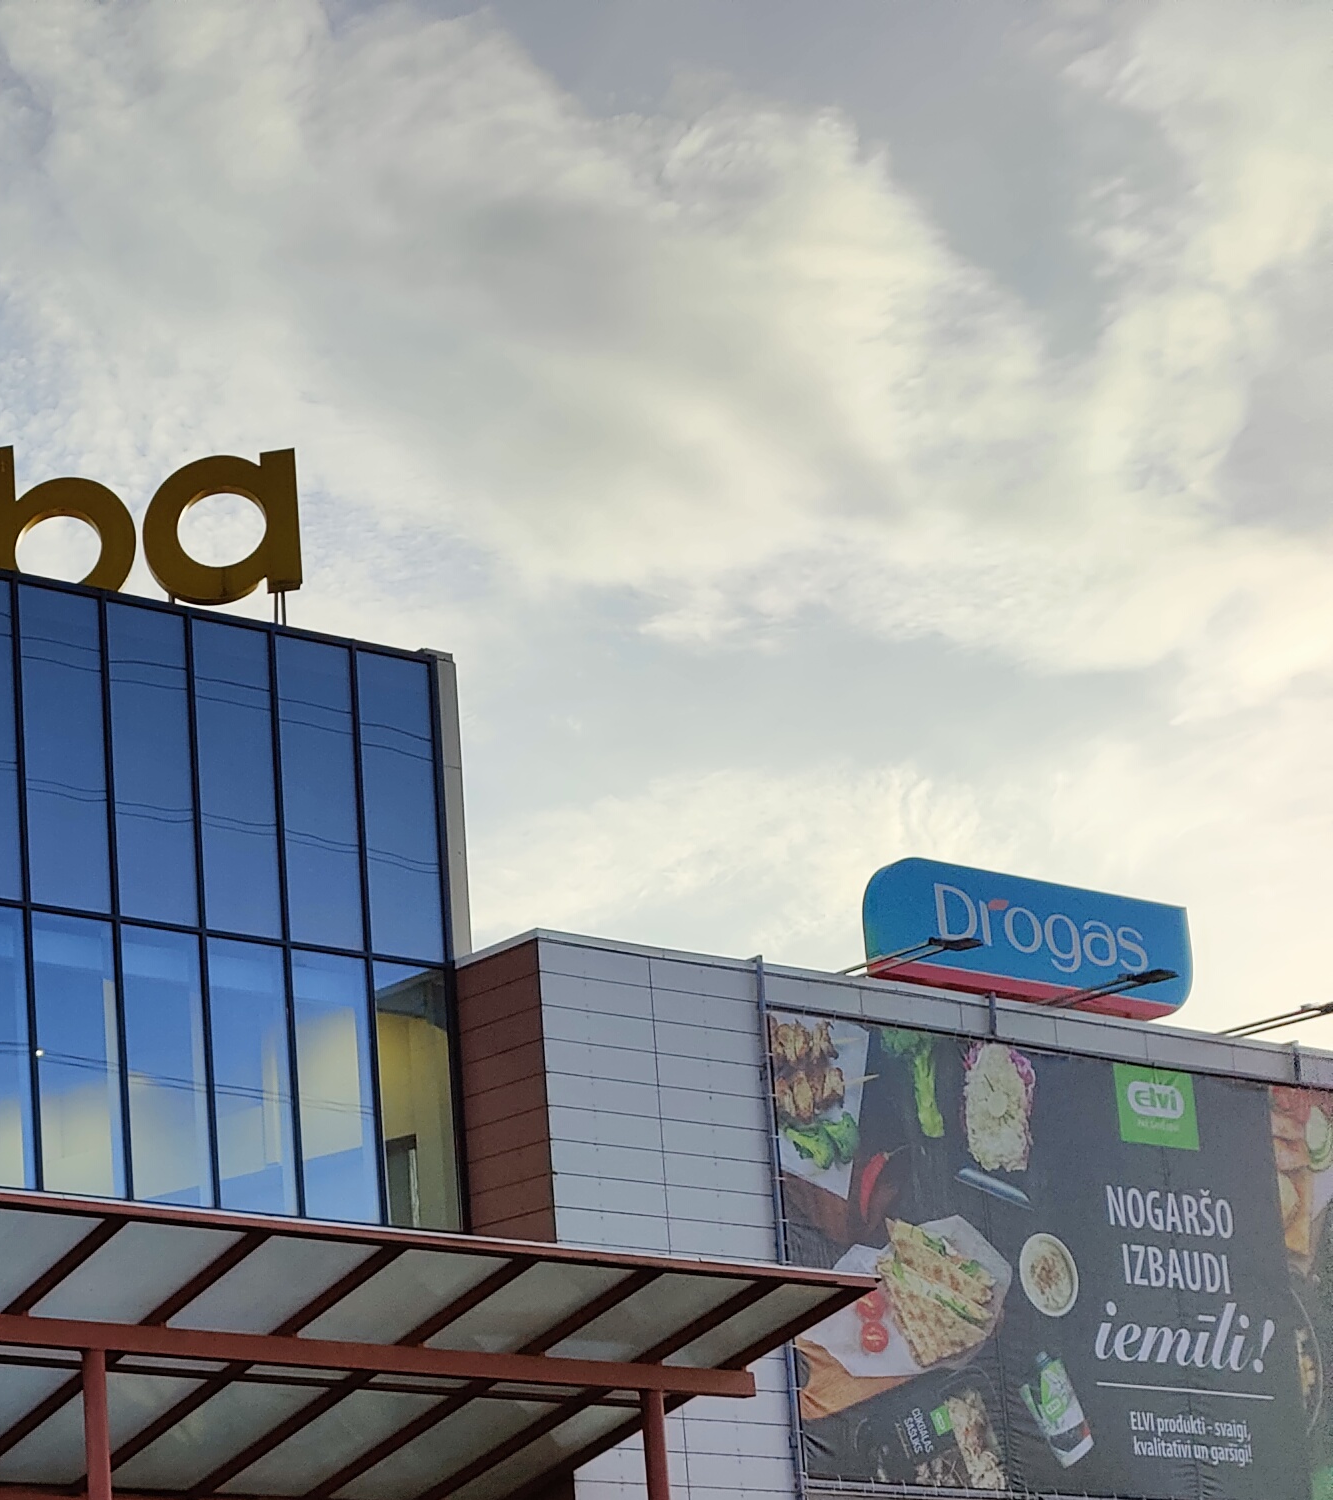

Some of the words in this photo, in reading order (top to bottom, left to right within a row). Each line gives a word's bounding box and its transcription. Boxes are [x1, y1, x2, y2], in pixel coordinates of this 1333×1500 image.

[934, 883, 1149, 973] Drogas
[1106, 1185, 1234, 1239] NOGARŠO
[1122, 1243, 1232, 1294] IZBAUDI
[1095, 1301, 1276, 1373] iemīli!
[1130, 1411, 1155, 1431] ELVI
[1157, 1414, 1206, 1436] produkti
[1215, 1420, 1252, 1441] svaigi,
[1133, 1436, 1192, 1459] kvalitatīvi
[1193, 1444, 1208, 1459] un
